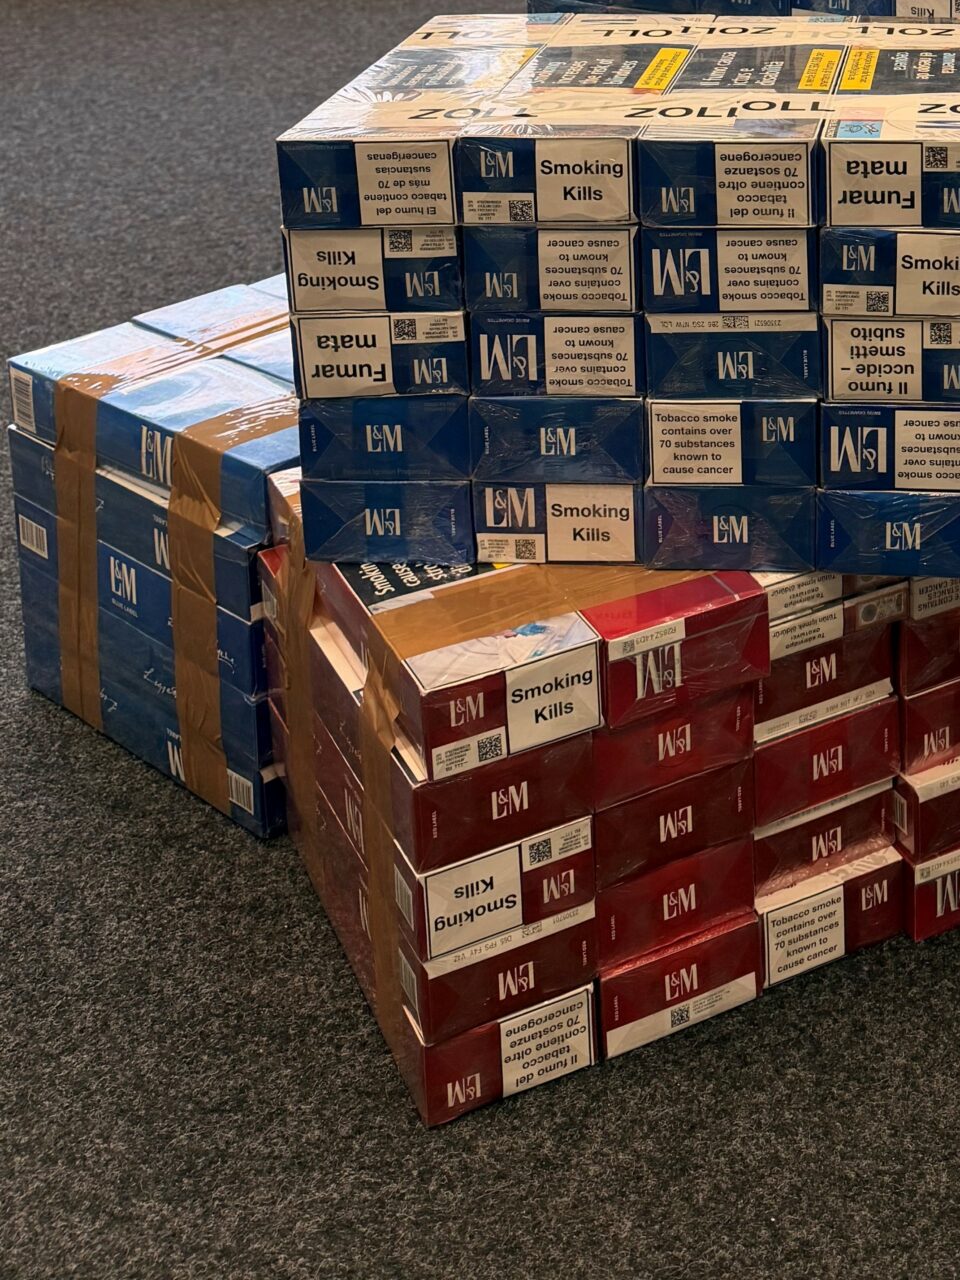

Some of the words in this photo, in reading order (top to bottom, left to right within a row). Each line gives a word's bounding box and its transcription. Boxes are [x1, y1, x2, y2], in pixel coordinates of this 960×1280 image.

[367, 151, 437, 162] cancerígenas
[719, 153, 802, 162] cancerogene
[375, 166, 431, 174] sustancias
[540, 159, 623, 178] Smoking
[724, 167, 777, 177] sostanze
[785, 167, 799, 177] 70
[846, 160, 907, 175] mata
[378, 180, 390, 188] 70
[393, 180, 409, 189] de
[411, 180, 431, 188] más
[718, 180, 747, 190] oltre
[750, 181, 805, 190] contiene
[364, 193, 409, 201] contiene
[411, 193, 447, 202] tabaco
[562, 186, 603, 200] Kills
[736, 195, 787, 204] tabacco
[838, 190, 915, 209] Fumar
[376, 206, 392, 216] del
[395, 207, 424, 216] humo
[426, 206, 436, 215] El
[730, 207, 750, 218] del
[753, 207, 786, 218] fumo
[316, 251, 356, 265] Kills
[652, 248, 711, 296] L&M
[298, 276, 379, 290] Smoking
[922, 280, 960, 296] Kills
[850, 327, 905, 340] subito
[849, 346, 906, 358] smetti
[857, 363, 915, 376] uccide
[848, 381, 892, 395] fumo
[899, 382, 908, 394] Il
[655, 414, 700, 422] Tobacco
[702, 414, 737, 422] smoke
[661, 427, 706, 435] contains
[710, 427, 732, 435] over
[659, 440, 672, 448] 70
[674, 440, 735, 448] substances
[673, 452, 708, 461] known
[711, 453, 721, 461] to
[662, 466, 695, 474] cause
[697, 466, 733, 474] cancer
[109, 554, 138, 606] L&M
[359, 563, 395, 596] Smokin
[511, 669, 593, 704] Smoking
[534, 700, 574, 724] Kills
[454, 876, 494, 898] Kills
[433, 893, 518, 933] Smoking
